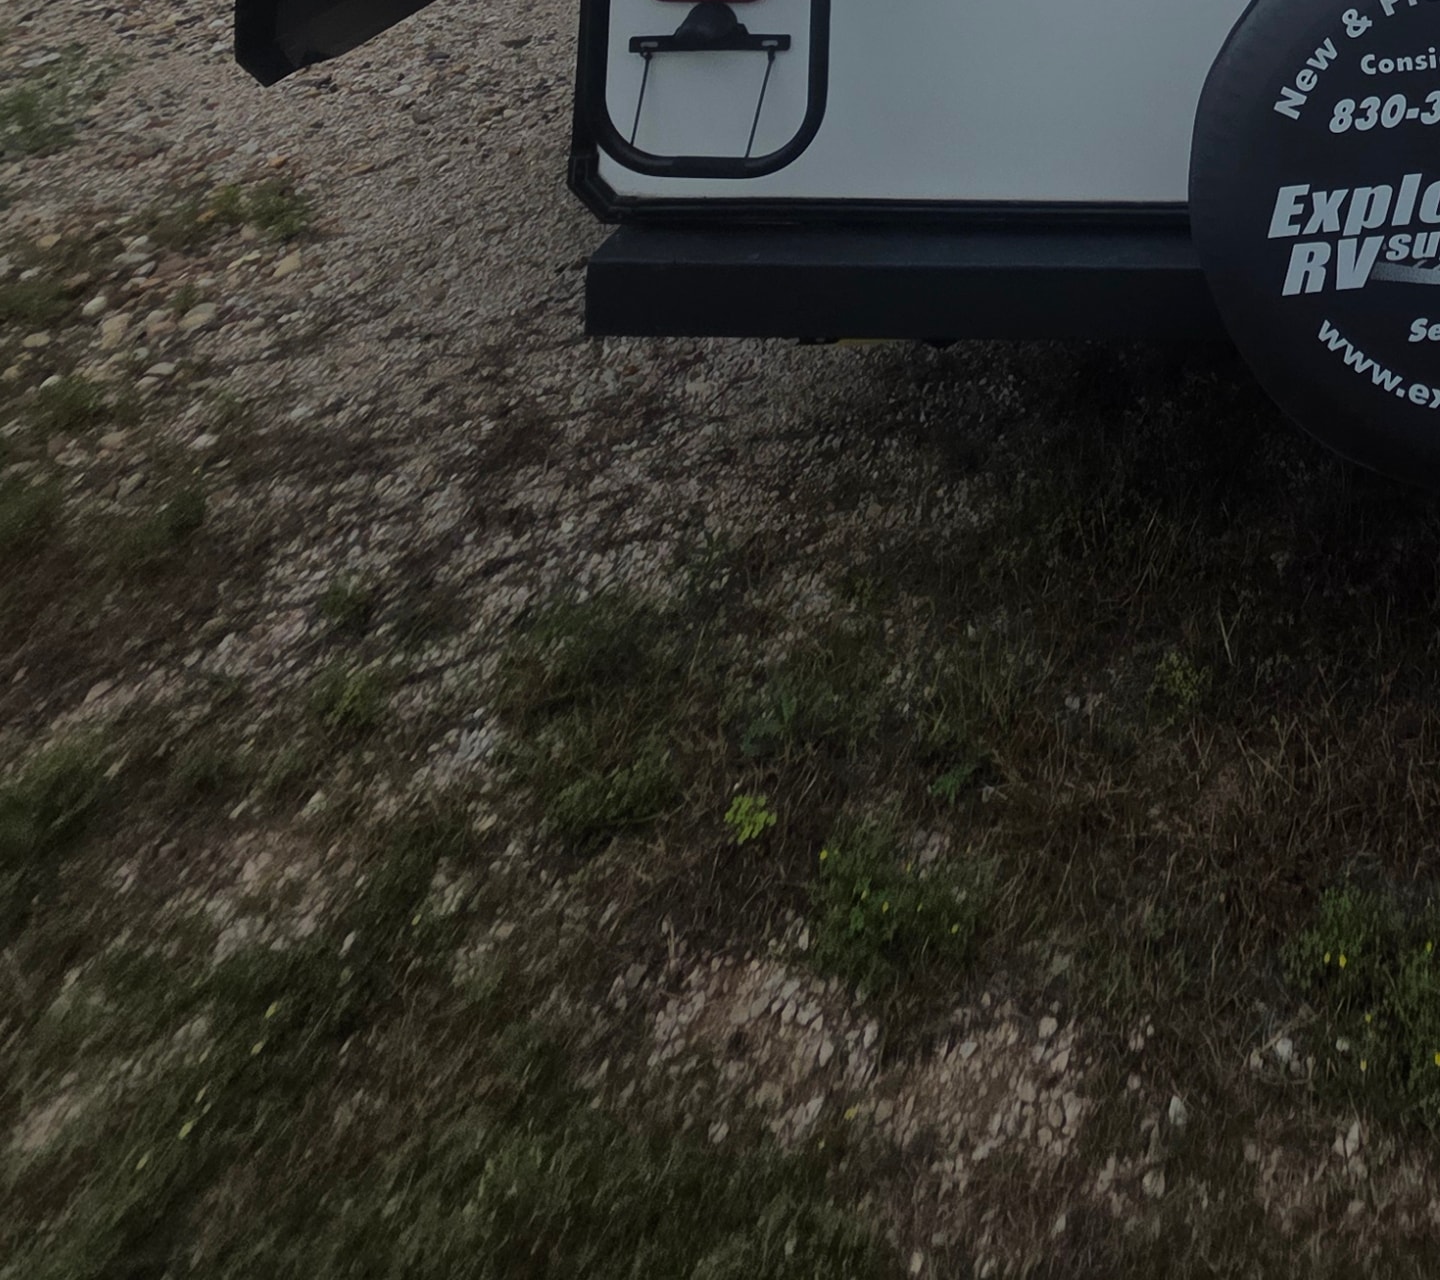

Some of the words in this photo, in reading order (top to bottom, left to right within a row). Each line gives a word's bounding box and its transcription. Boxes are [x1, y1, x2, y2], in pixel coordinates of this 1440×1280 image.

[1273, 38, 1338, 120] New
[1341, 8, 1373, 38] &
[1281, 236, 1385, 296] RV
